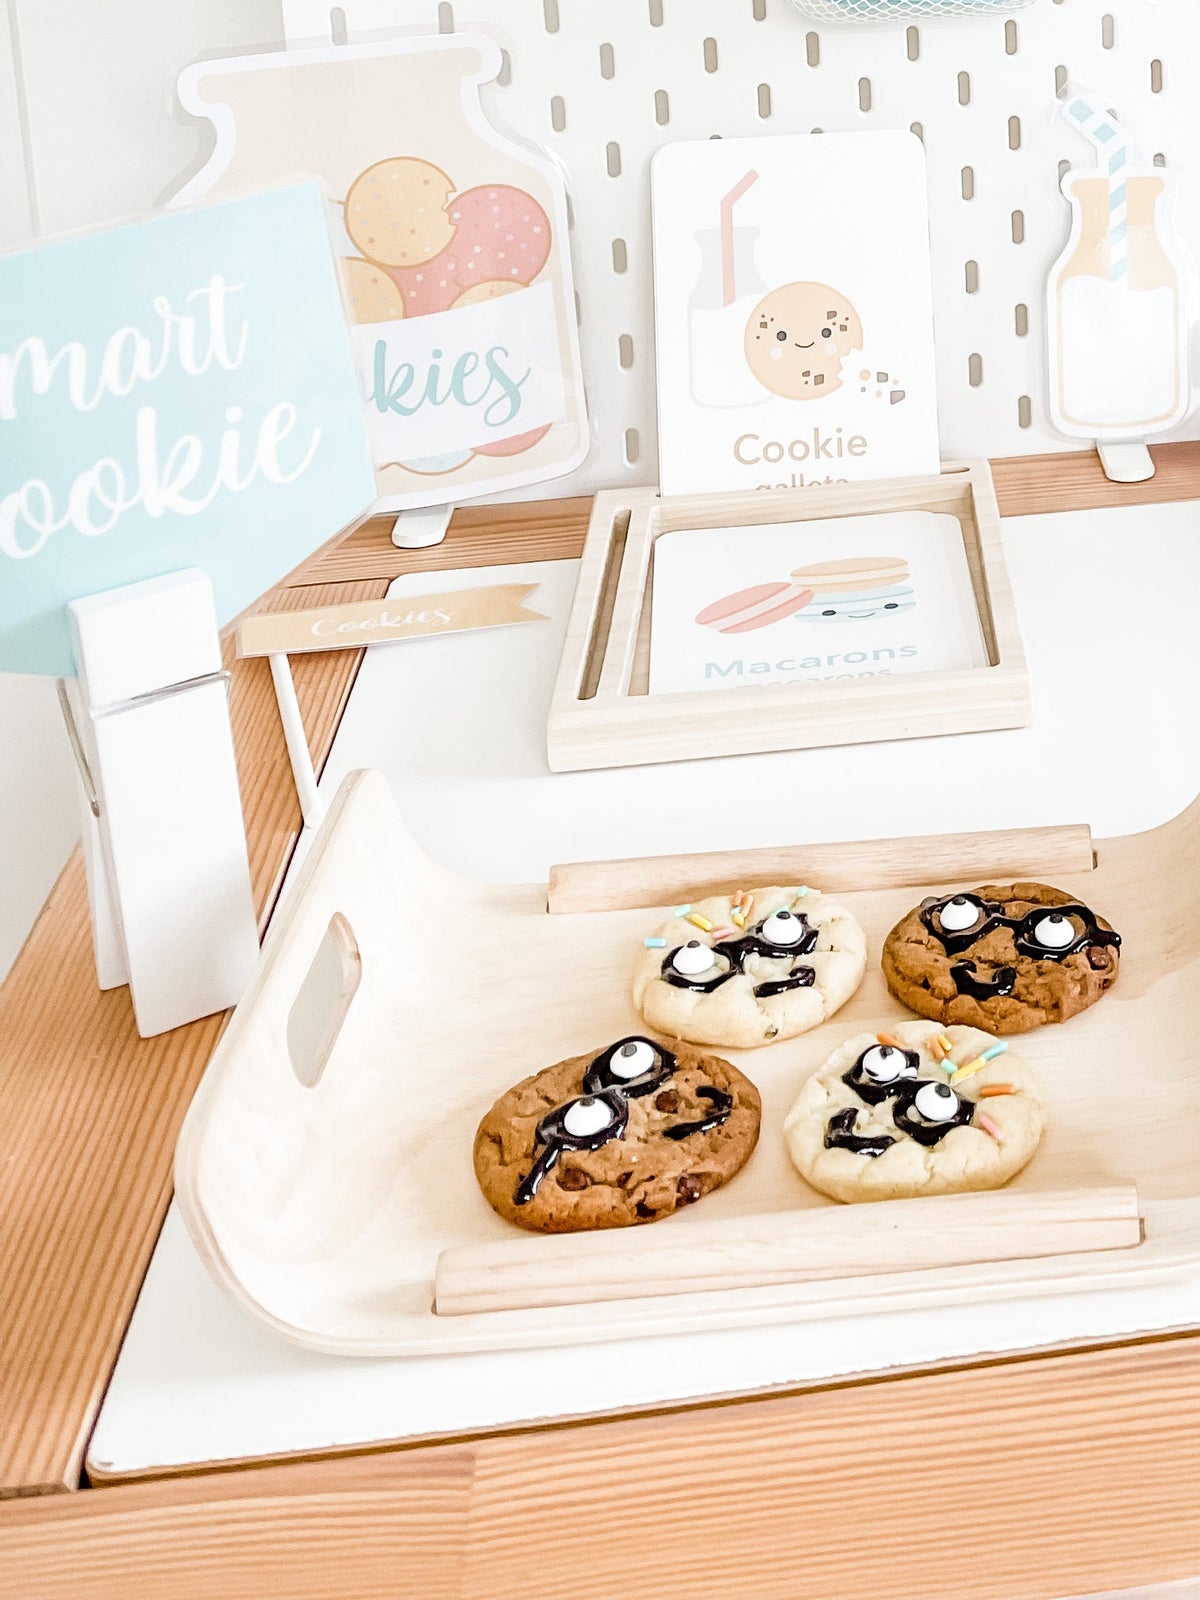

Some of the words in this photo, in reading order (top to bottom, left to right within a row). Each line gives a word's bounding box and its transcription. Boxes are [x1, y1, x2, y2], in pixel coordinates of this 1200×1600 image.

[0, 273, 247, 419] mart
[368, 340, 530, 426] kies
[733, 427, 868, 466] Cookie
[0, 402, 321, 560] ookie
[311, 603, 453, 637] Cookies
[705, 644, 918, 679] Macarons
